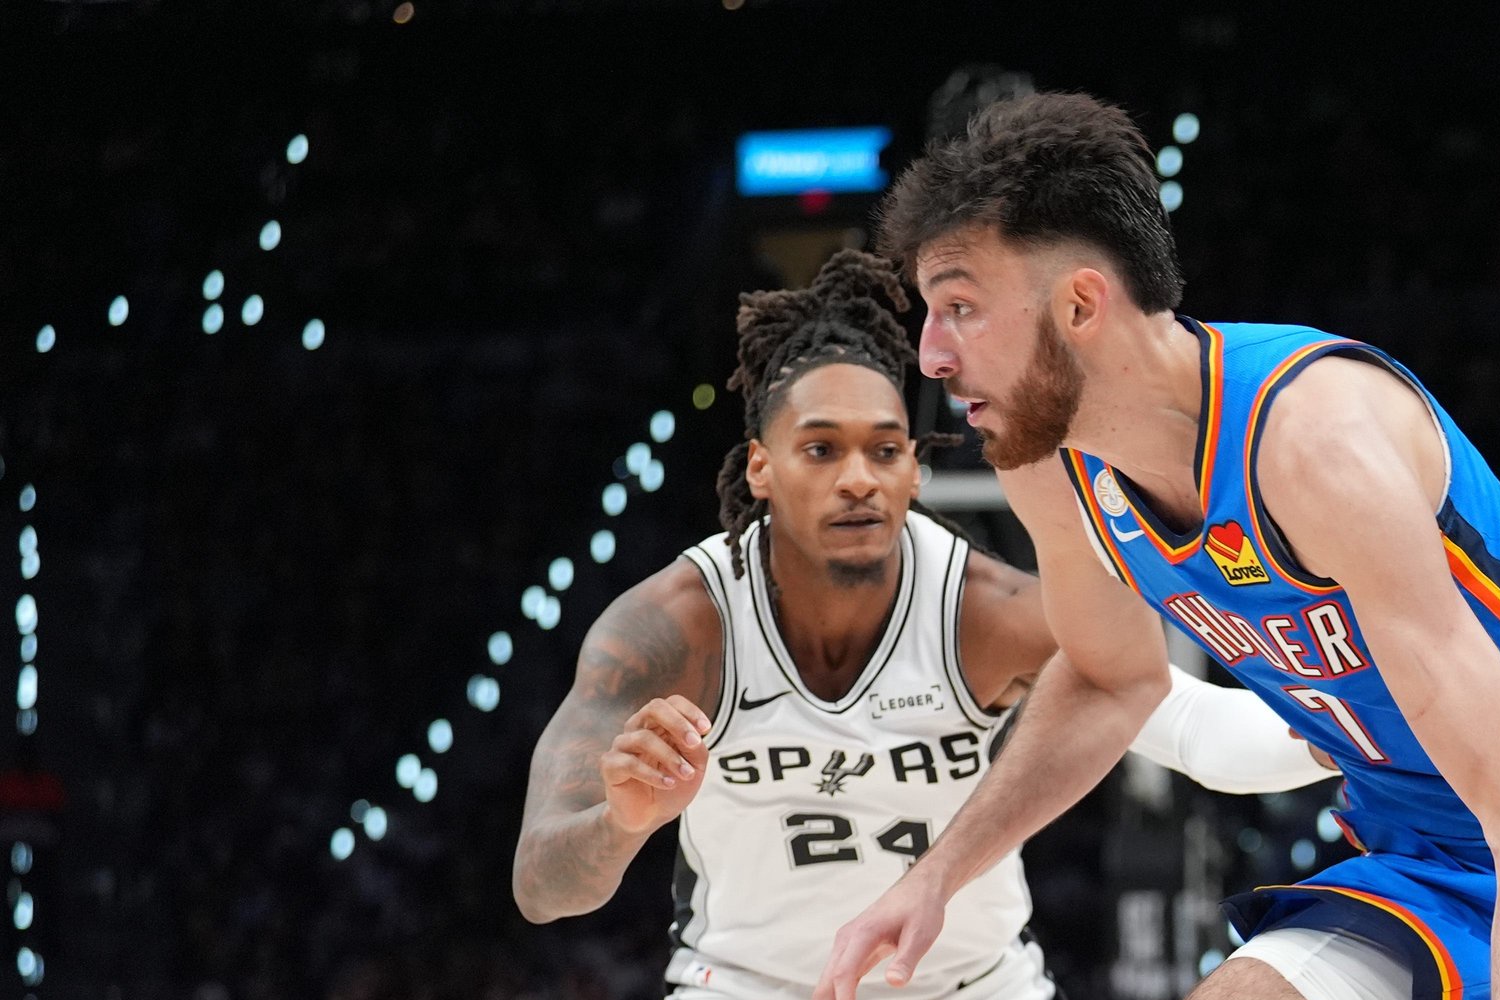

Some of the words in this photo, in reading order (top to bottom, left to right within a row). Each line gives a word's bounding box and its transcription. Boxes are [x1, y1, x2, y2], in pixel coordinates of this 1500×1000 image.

[880, 694, 933, 711] LEDGER
[1283, 686, 1390, 764] 7
[718, 731, 980, 795] SPURS
[781, 811, 932, 870] 24
